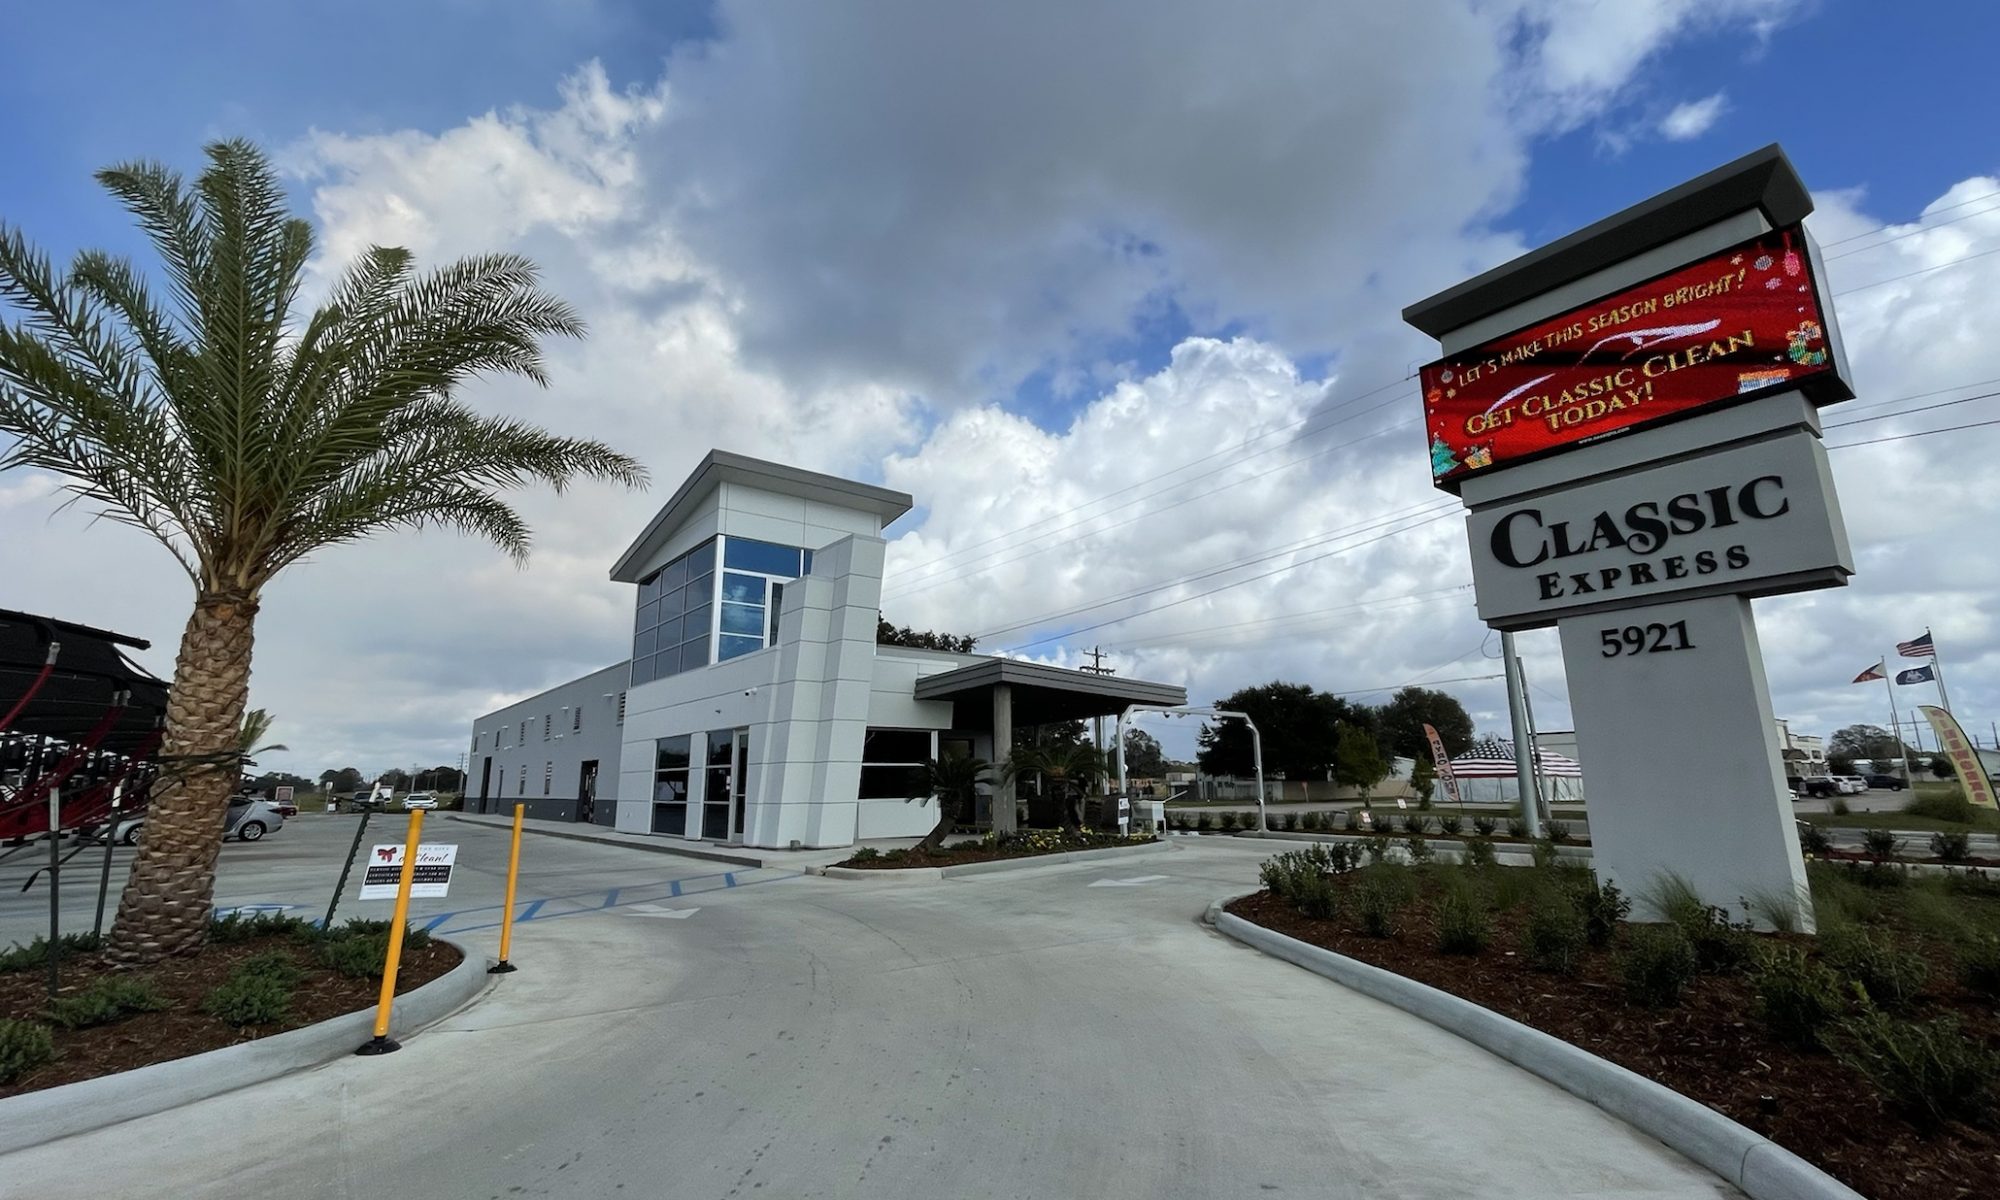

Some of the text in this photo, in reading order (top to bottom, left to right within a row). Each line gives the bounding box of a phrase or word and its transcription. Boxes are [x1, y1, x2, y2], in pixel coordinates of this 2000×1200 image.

[1459, 267, 1747, 387] LET'S MAKE THIS SEASON BRIGHT!
[1466, 329, 1755, 434] GET CLASSIC CLEAN
[1545, 381, 1654, 431] TODAY!
[1490, 475, 1789, 568] CLASSIC
[1538, 545, 1750, 600] EXPRESS
[1600, 620, 1696, 658] 5921
[418, 853, 449, 862] lean!
